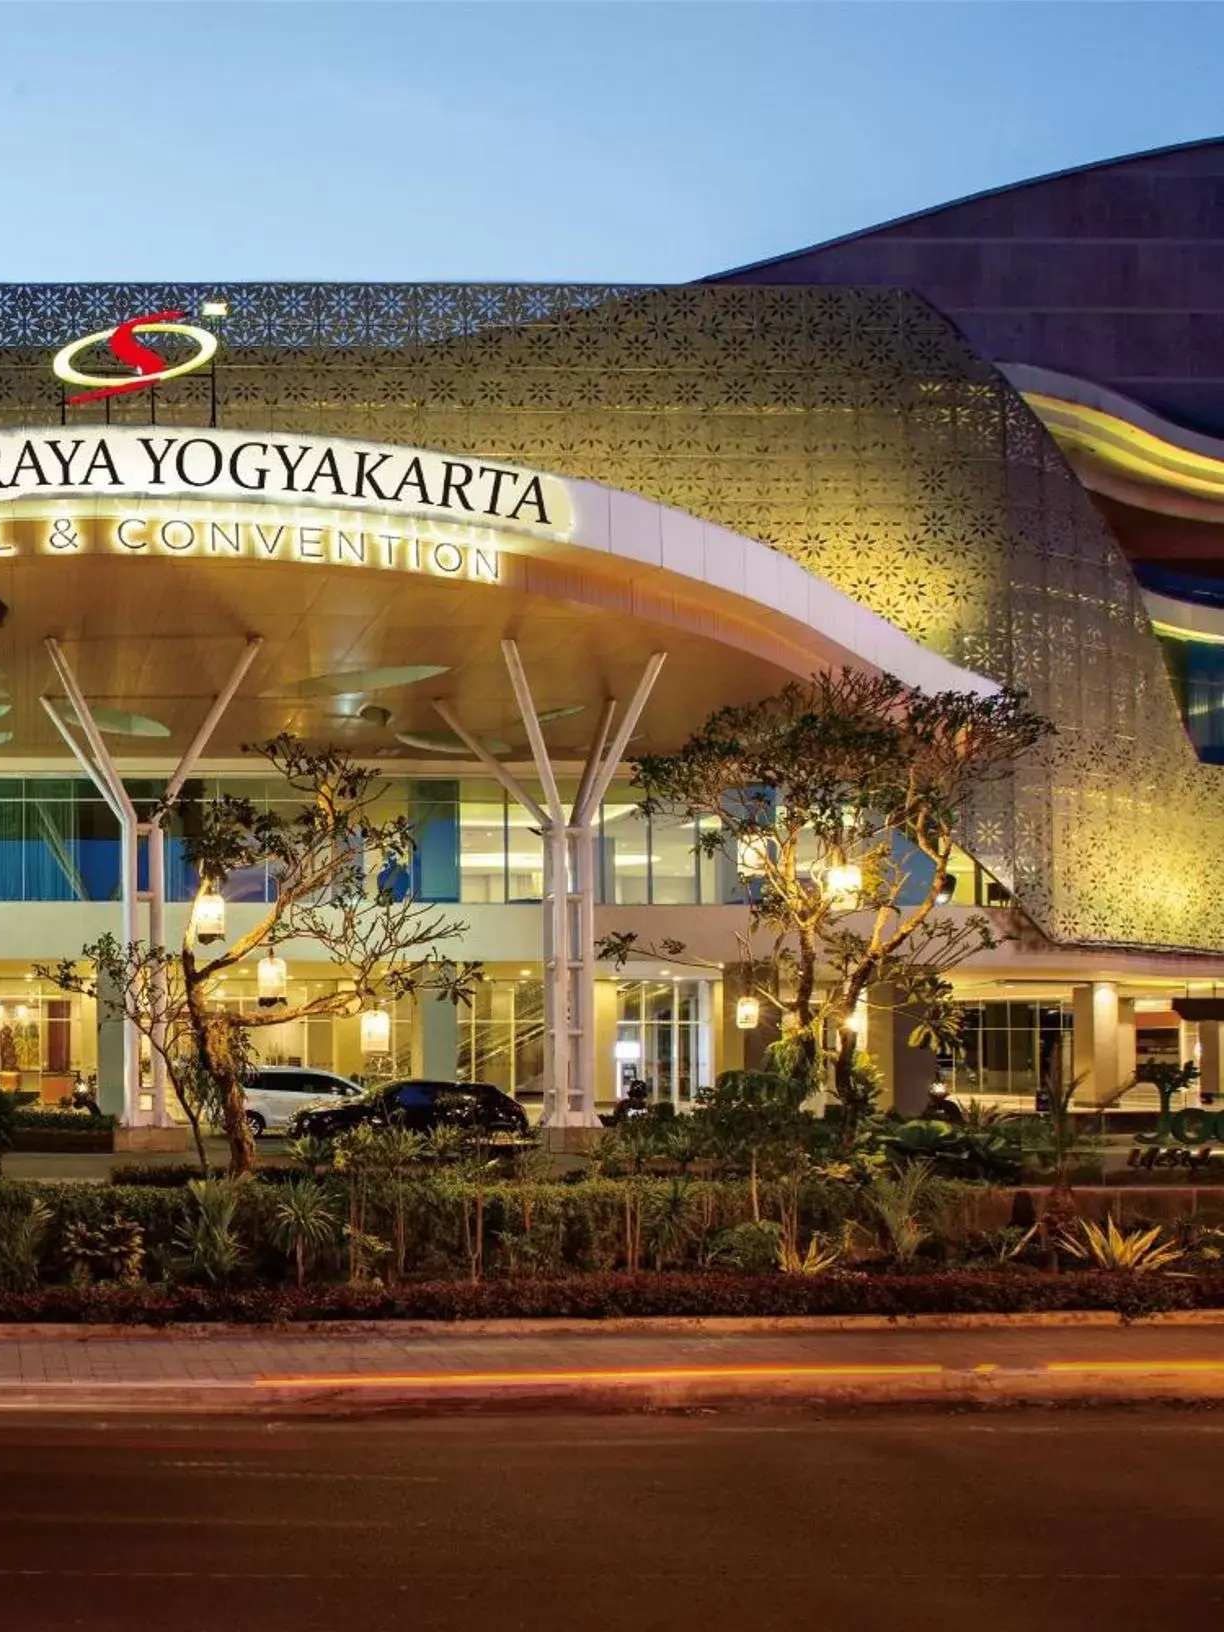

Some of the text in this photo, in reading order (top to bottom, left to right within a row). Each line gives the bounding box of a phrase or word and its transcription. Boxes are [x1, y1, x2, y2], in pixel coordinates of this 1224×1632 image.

[136, 437, 553, 525] YOGYAKARTA
[48, 518, 80, 550] &
[117, 518, 500, 579] CONVENTION
